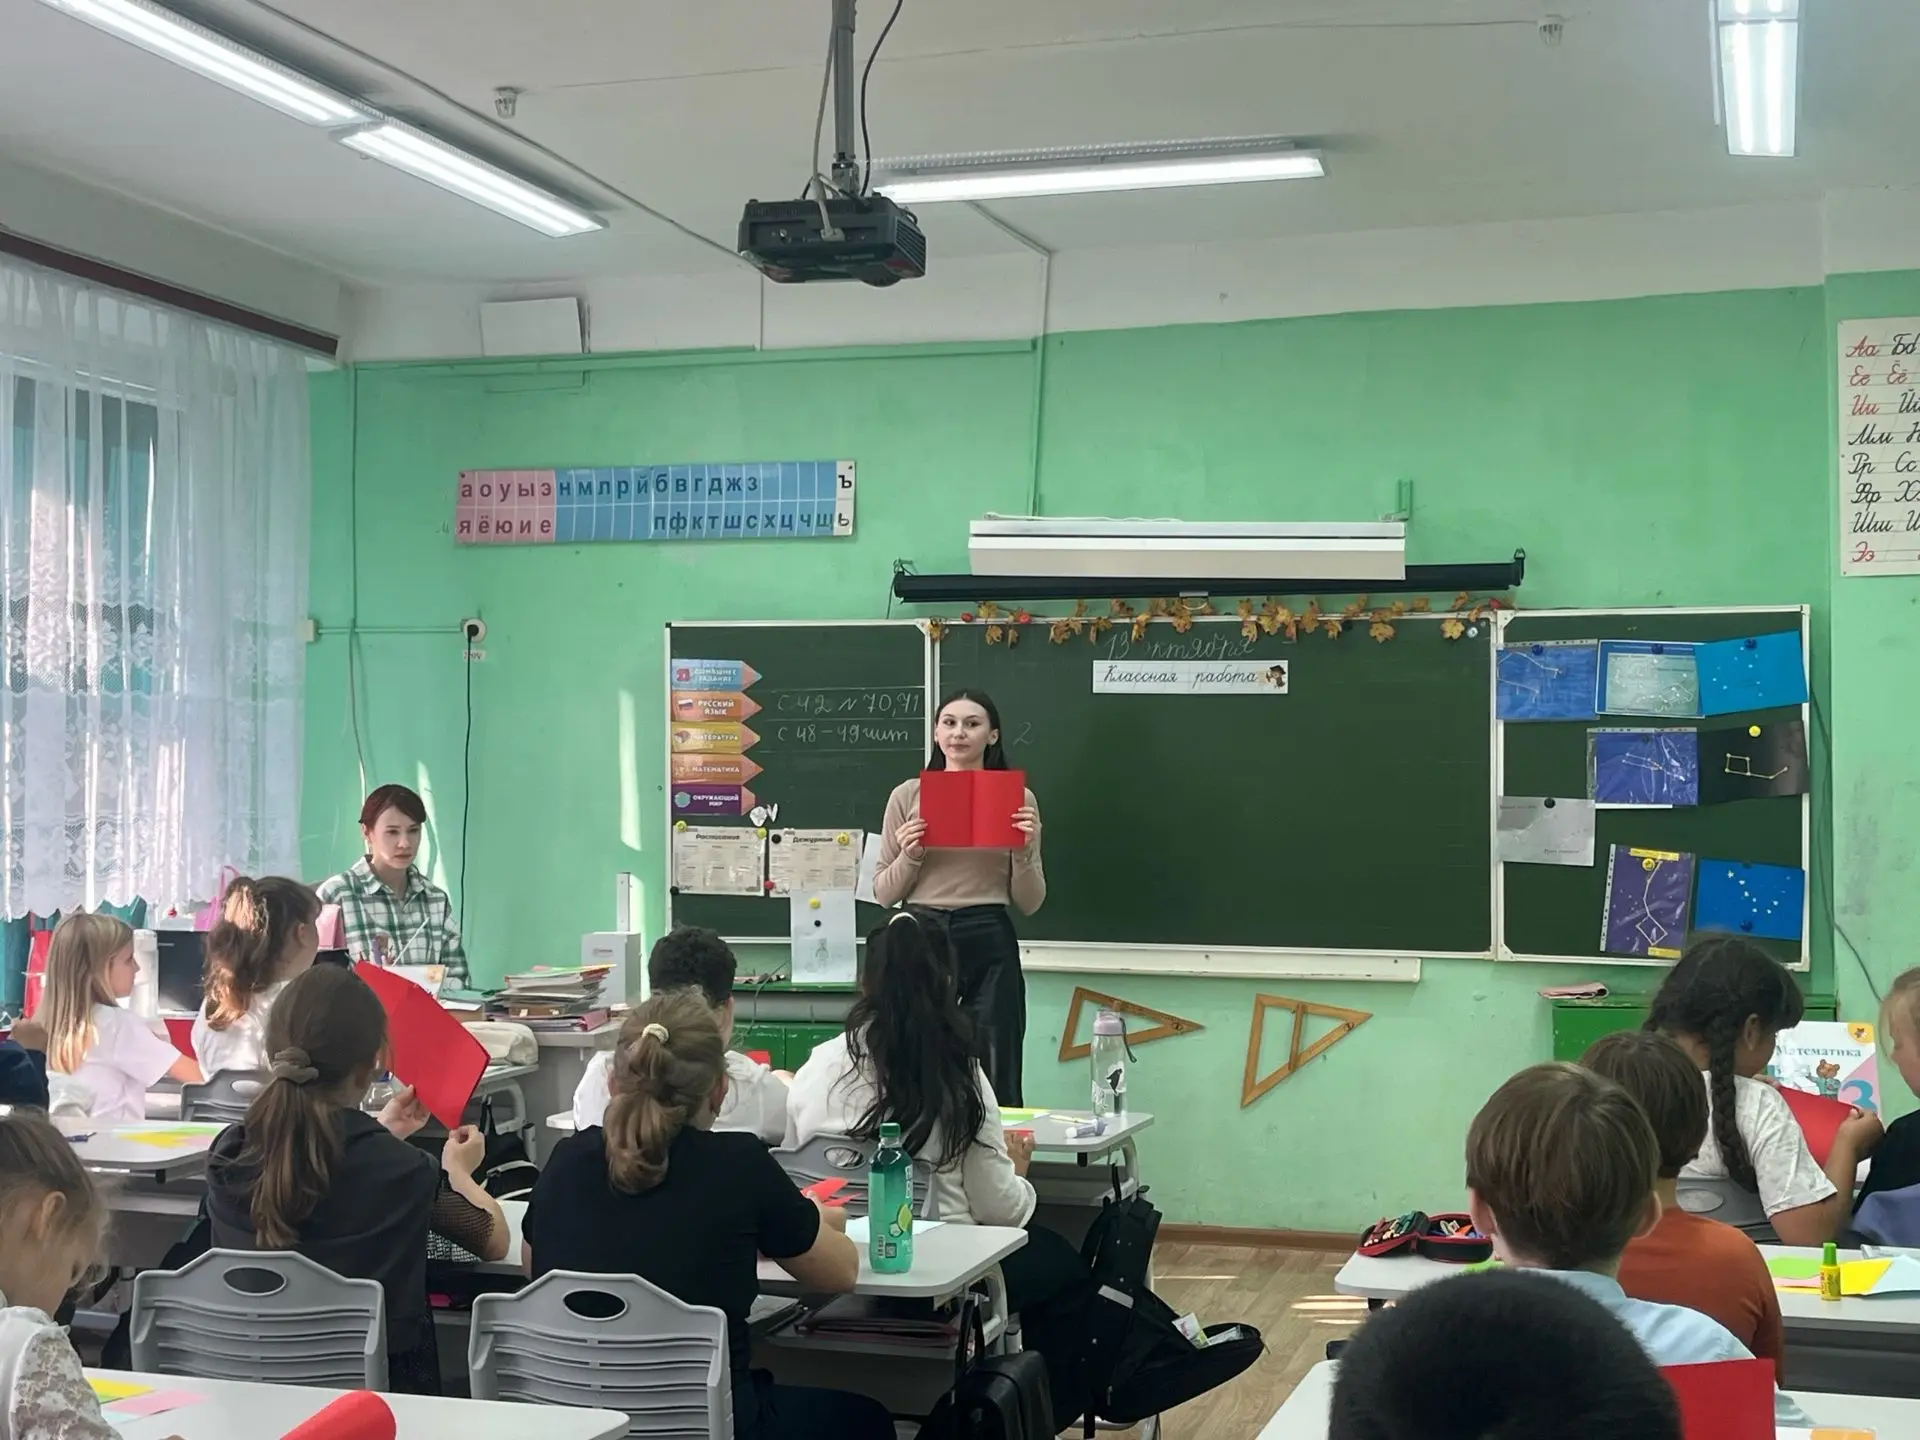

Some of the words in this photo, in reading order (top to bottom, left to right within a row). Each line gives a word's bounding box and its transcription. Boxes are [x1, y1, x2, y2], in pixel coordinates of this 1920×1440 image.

[1846, 335, 1879, 357] Аа
[1851, 393, 1880, 416] Ии
[1848, 423, 1894, 445] Мм
[1848, 452, 1876, 483] Рр
[1853, 511, 1893, 533] Шш
[1104, 630, 1130, 660] 13
[1104, 664, 1178, 683] Классная
[1192, 663, 1259, 689] работа
[698, 699, 735, 708] РУССКИЙ
[797, 694, 832, 714] 42
[692, 794, 739, 802] ОКРУЖАЮЩИЙ
[1776, 1045, 1862, 1058] Математика
